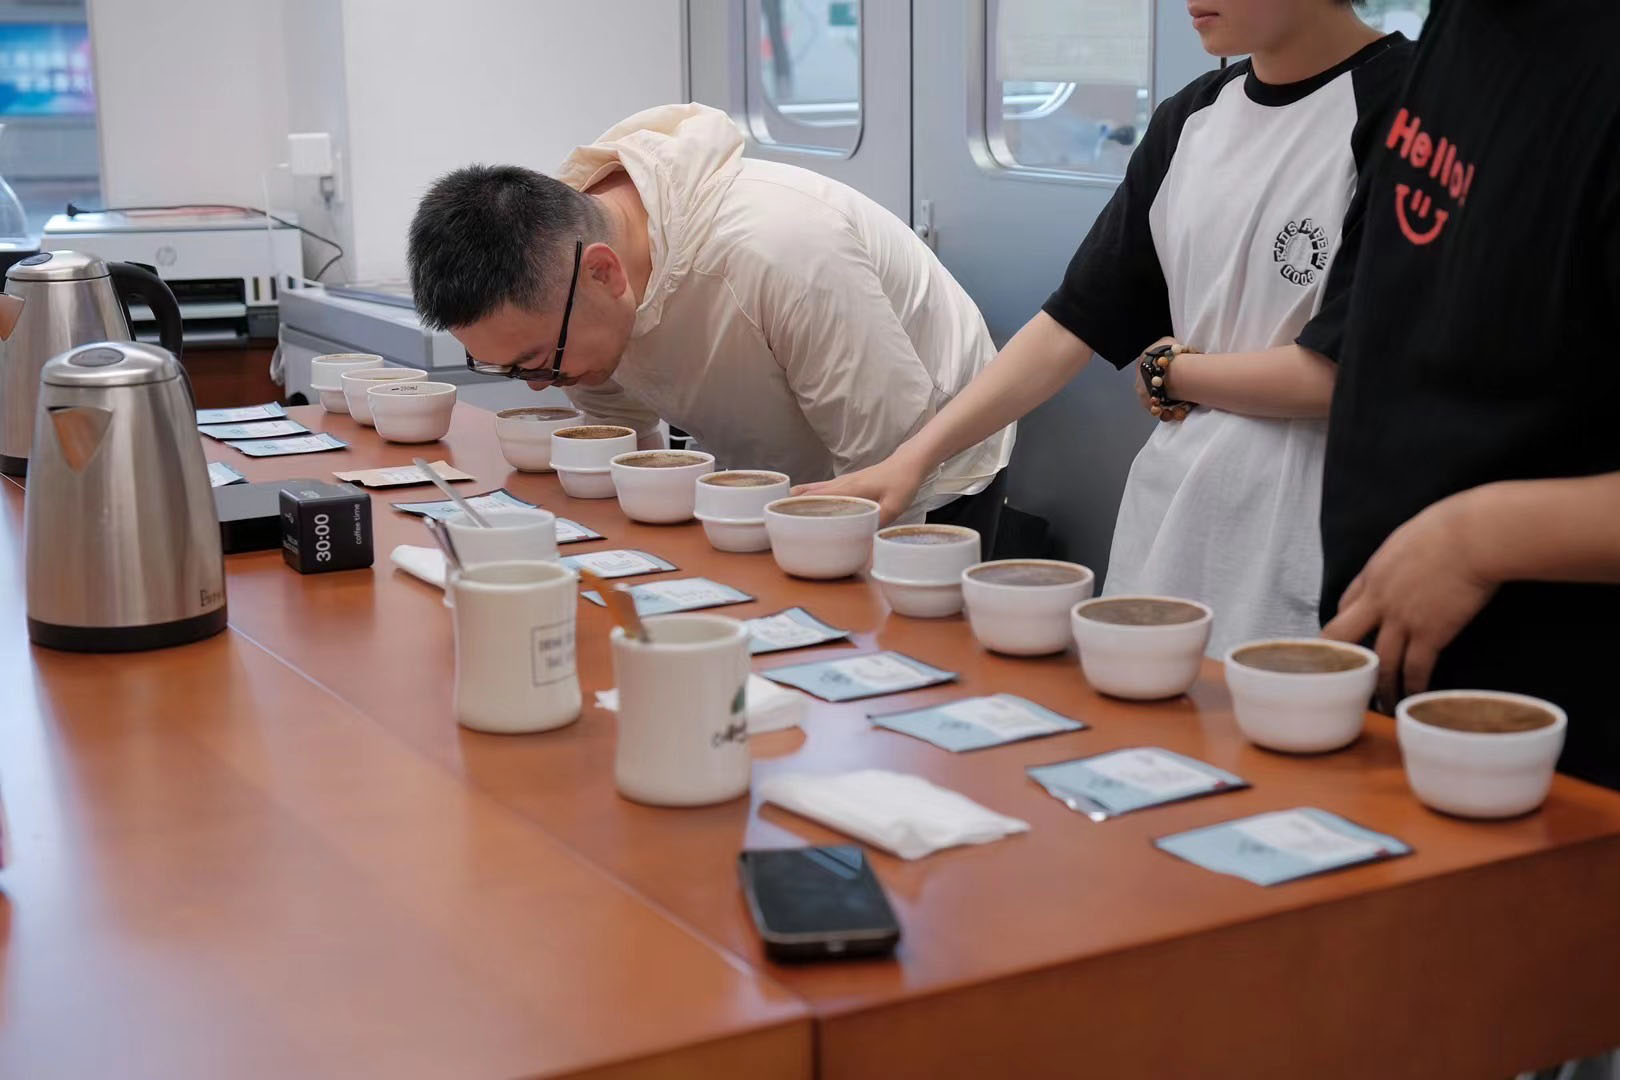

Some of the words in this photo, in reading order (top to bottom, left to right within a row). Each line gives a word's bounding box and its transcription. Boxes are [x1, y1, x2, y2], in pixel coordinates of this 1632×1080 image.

[1385, 108, 1476, 208] Hello!
[1273, 220, 1298, 262] KIDS
[1280, 264, 1315, 286] GOOD
[352, 503, 361, 521] time
[314, 513, 332, 562] 30:00
[353, 521, 362, 545] coffee
